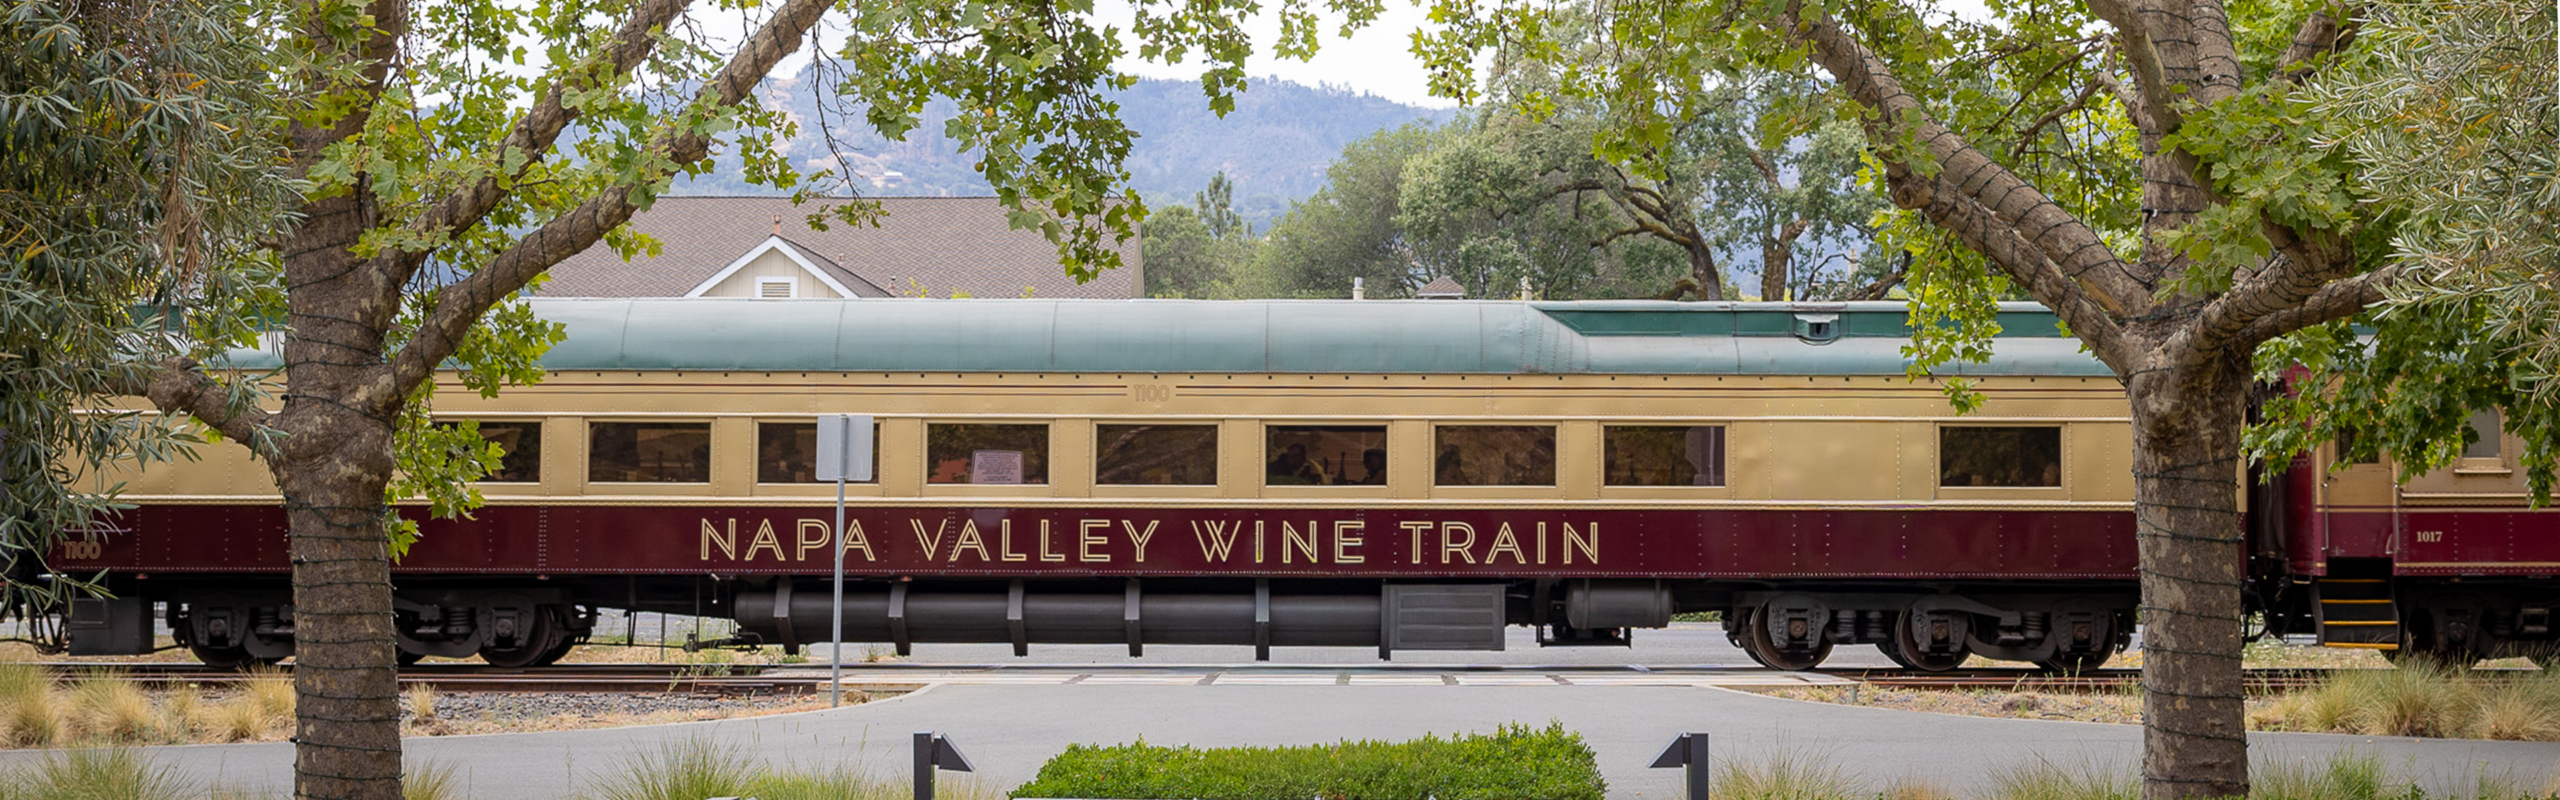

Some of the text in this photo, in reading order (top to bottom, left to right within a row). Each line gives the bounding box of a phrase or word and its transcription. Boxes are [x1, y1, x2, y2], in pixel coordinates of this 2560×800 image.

[1132, 384, 1170, 402] 1100
[700, 518, 1599, 565] NAPA VALLEY WINE TRAIN
[2416, 531, 2443, 542] 1017
[64, 541, 101, 559] 1100
